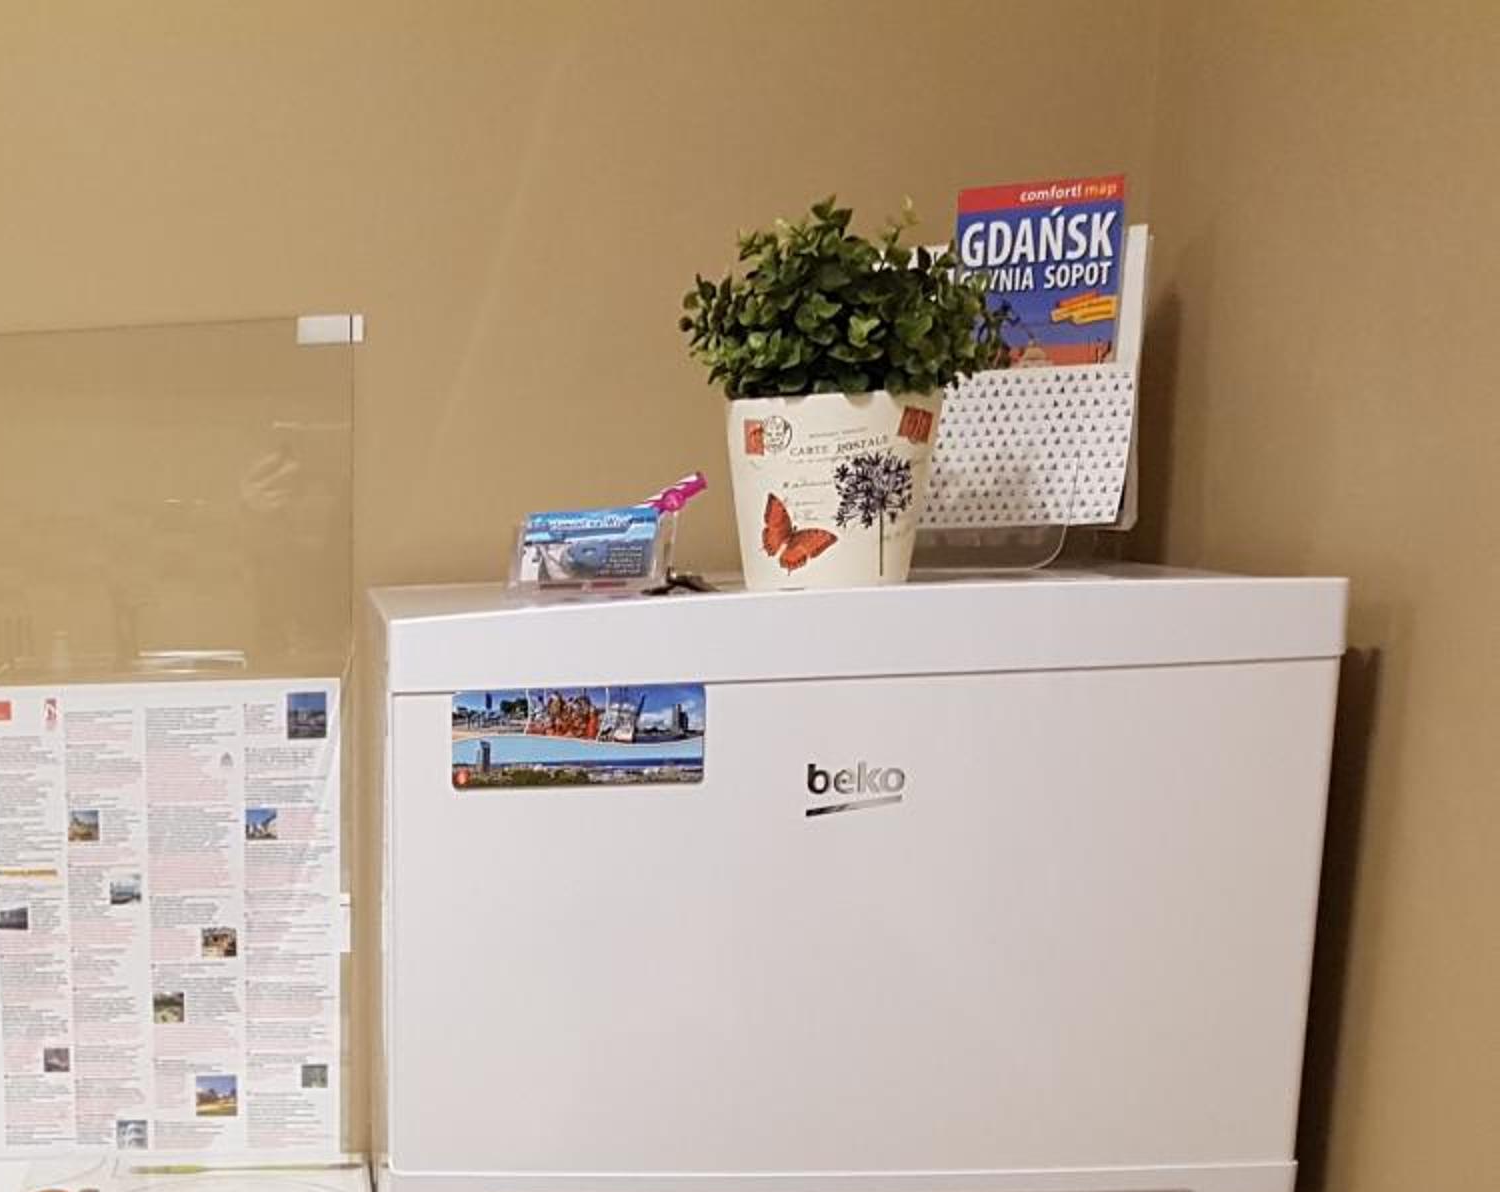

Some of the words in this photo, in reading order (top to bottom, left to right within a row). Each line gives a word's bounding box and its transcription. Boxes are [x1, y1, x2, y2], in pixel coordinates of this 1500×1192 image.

[1020, 184, 1083, 204] comfort!
[1084, 182, 1117, 199] map
[961, 205, 1117, 268] GDAŃSK
[1043, 260, 1112, 289] SOPOT
[806, 761, 905, 795] beko
